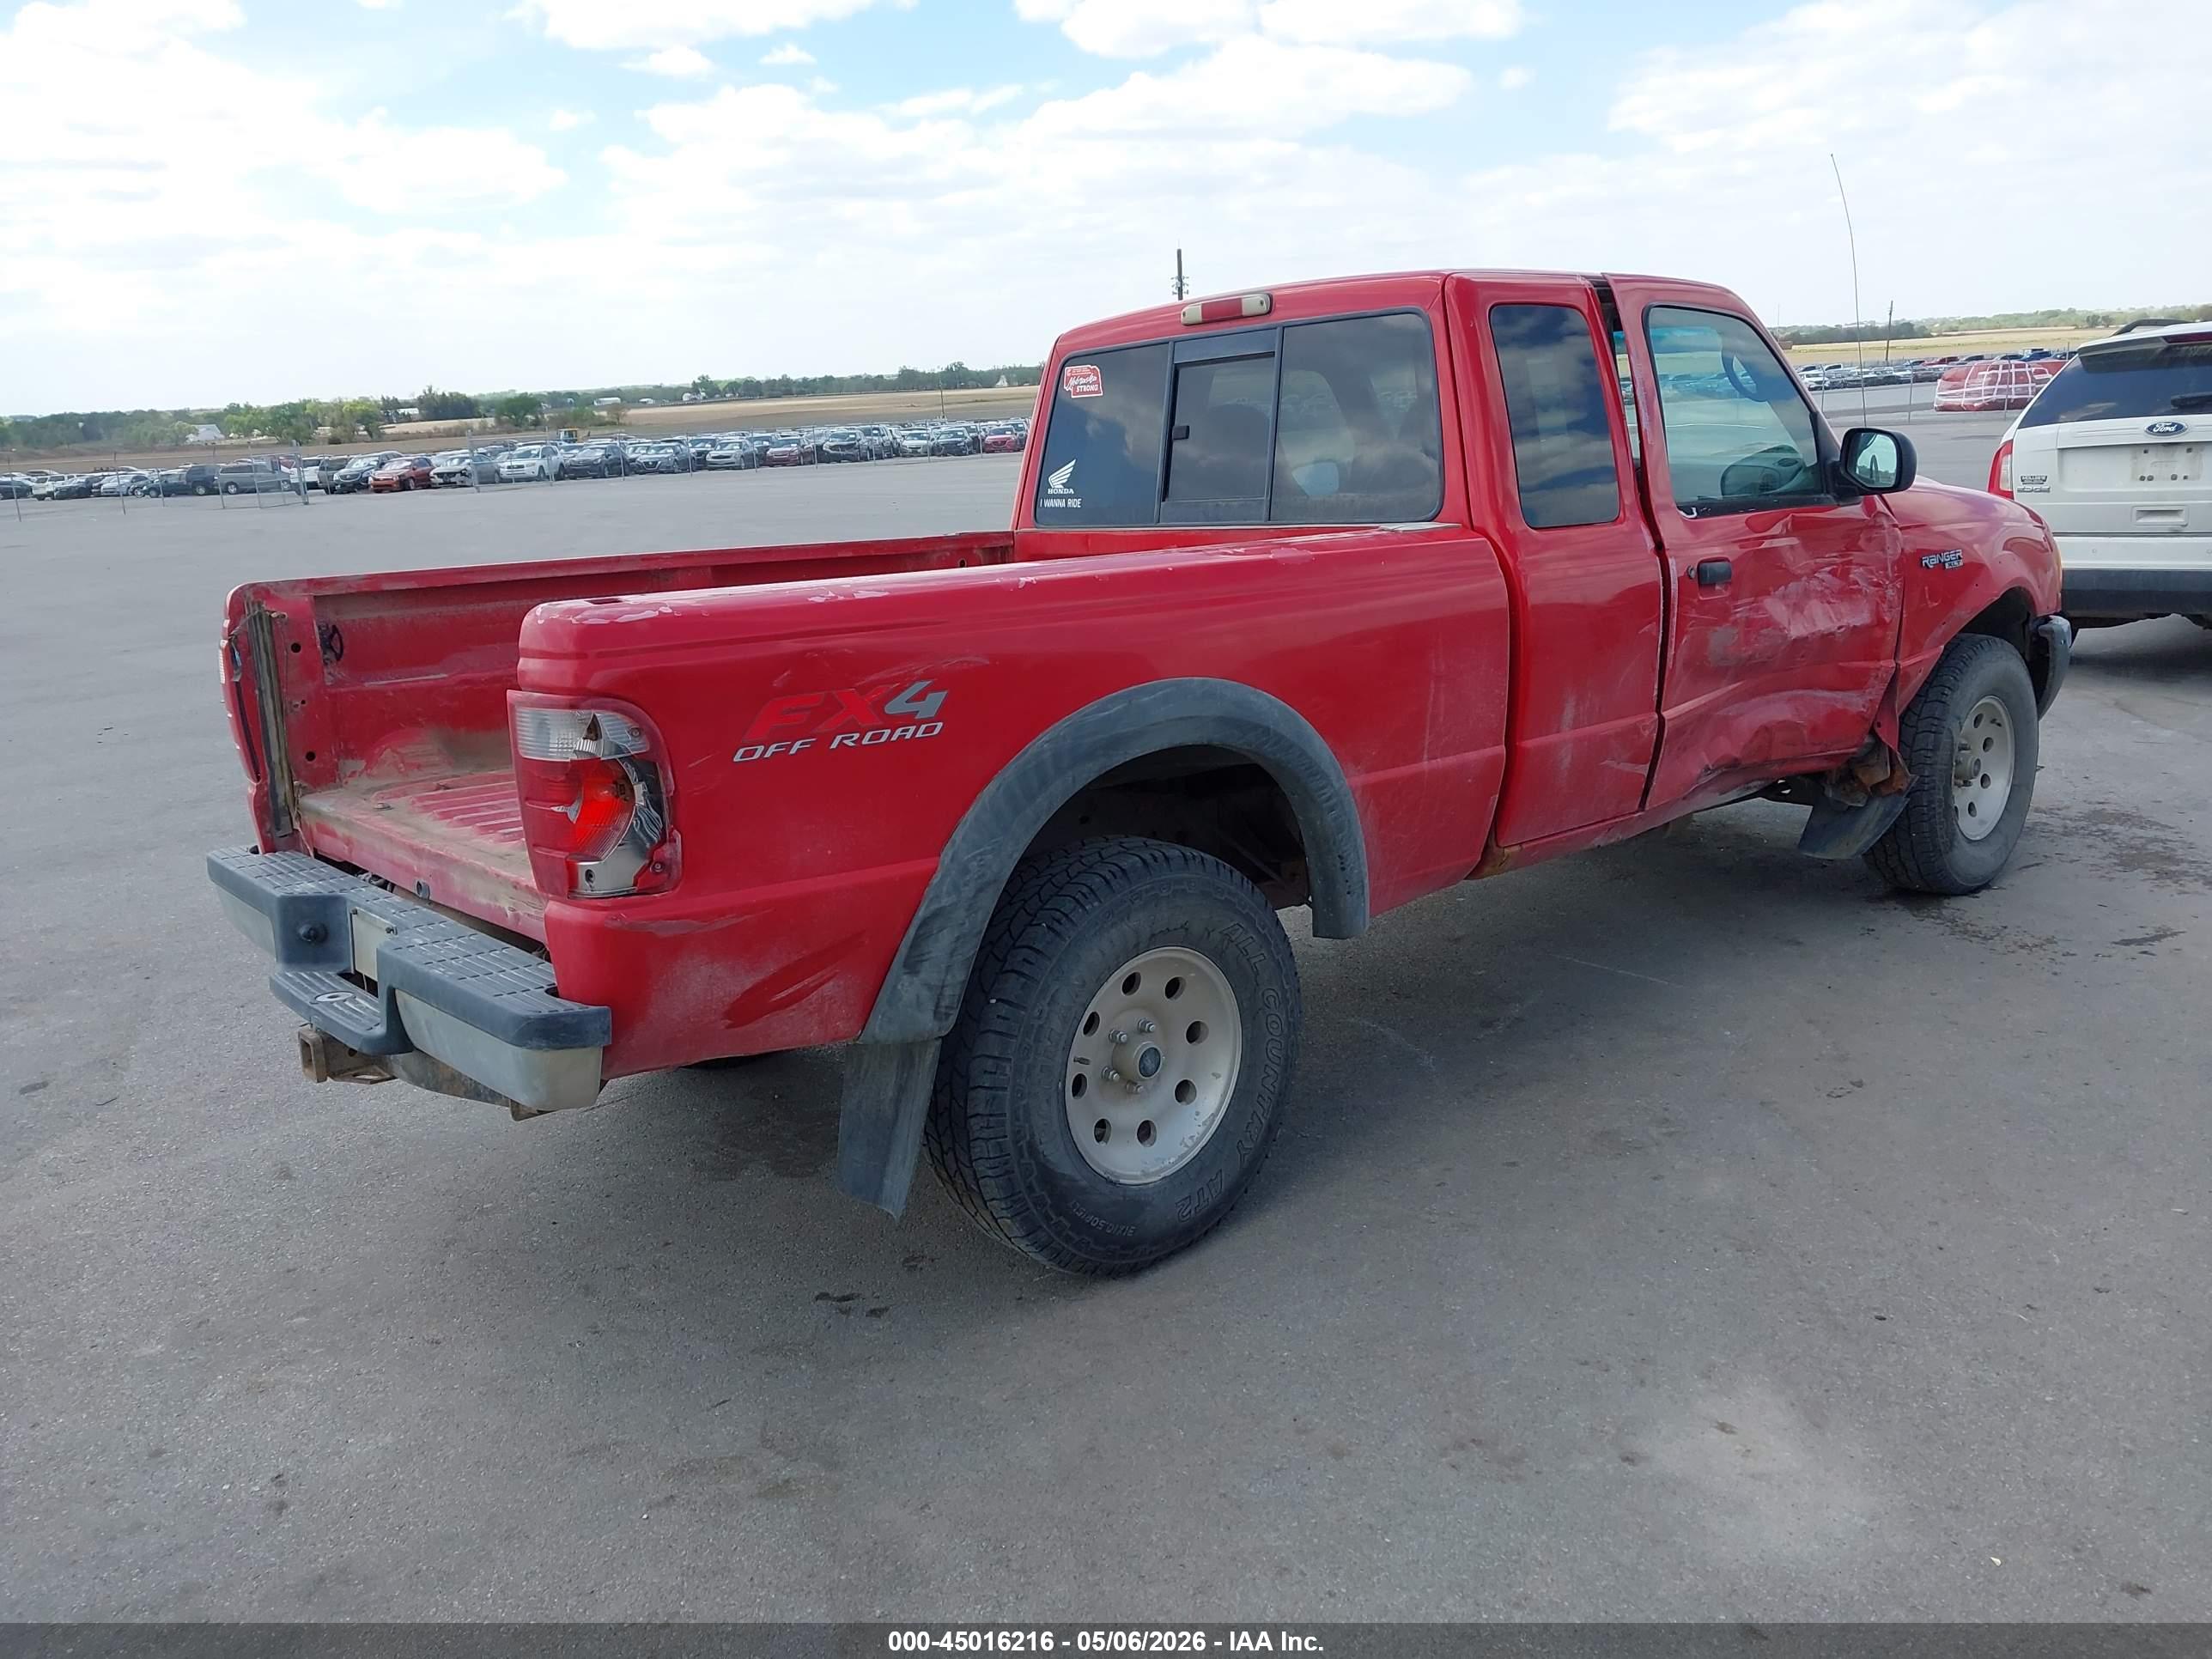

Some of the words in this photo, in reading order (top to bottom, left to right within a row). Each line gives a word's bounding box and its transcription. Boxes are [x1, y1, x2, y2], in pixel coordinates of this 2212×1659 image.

[1076, 384, 1098, 392] STRONG
[2153, 422, 2178, 433] Ford
[1040, 498, 1043, 507] I
[1043, 498, 1066, 507] WANNA
[1067, 498, 1082, 507] RIDE
[741, 679, 948, 743] FX4
[733, 738, 817, 762] OFF
[830, 721, 944, 749] ROAD
[1220, 922, 1267, 975] ALL
[1237, 988, 1284, 1168] COUNTRY
[1175, 1169, 1223, 1223] AT2
